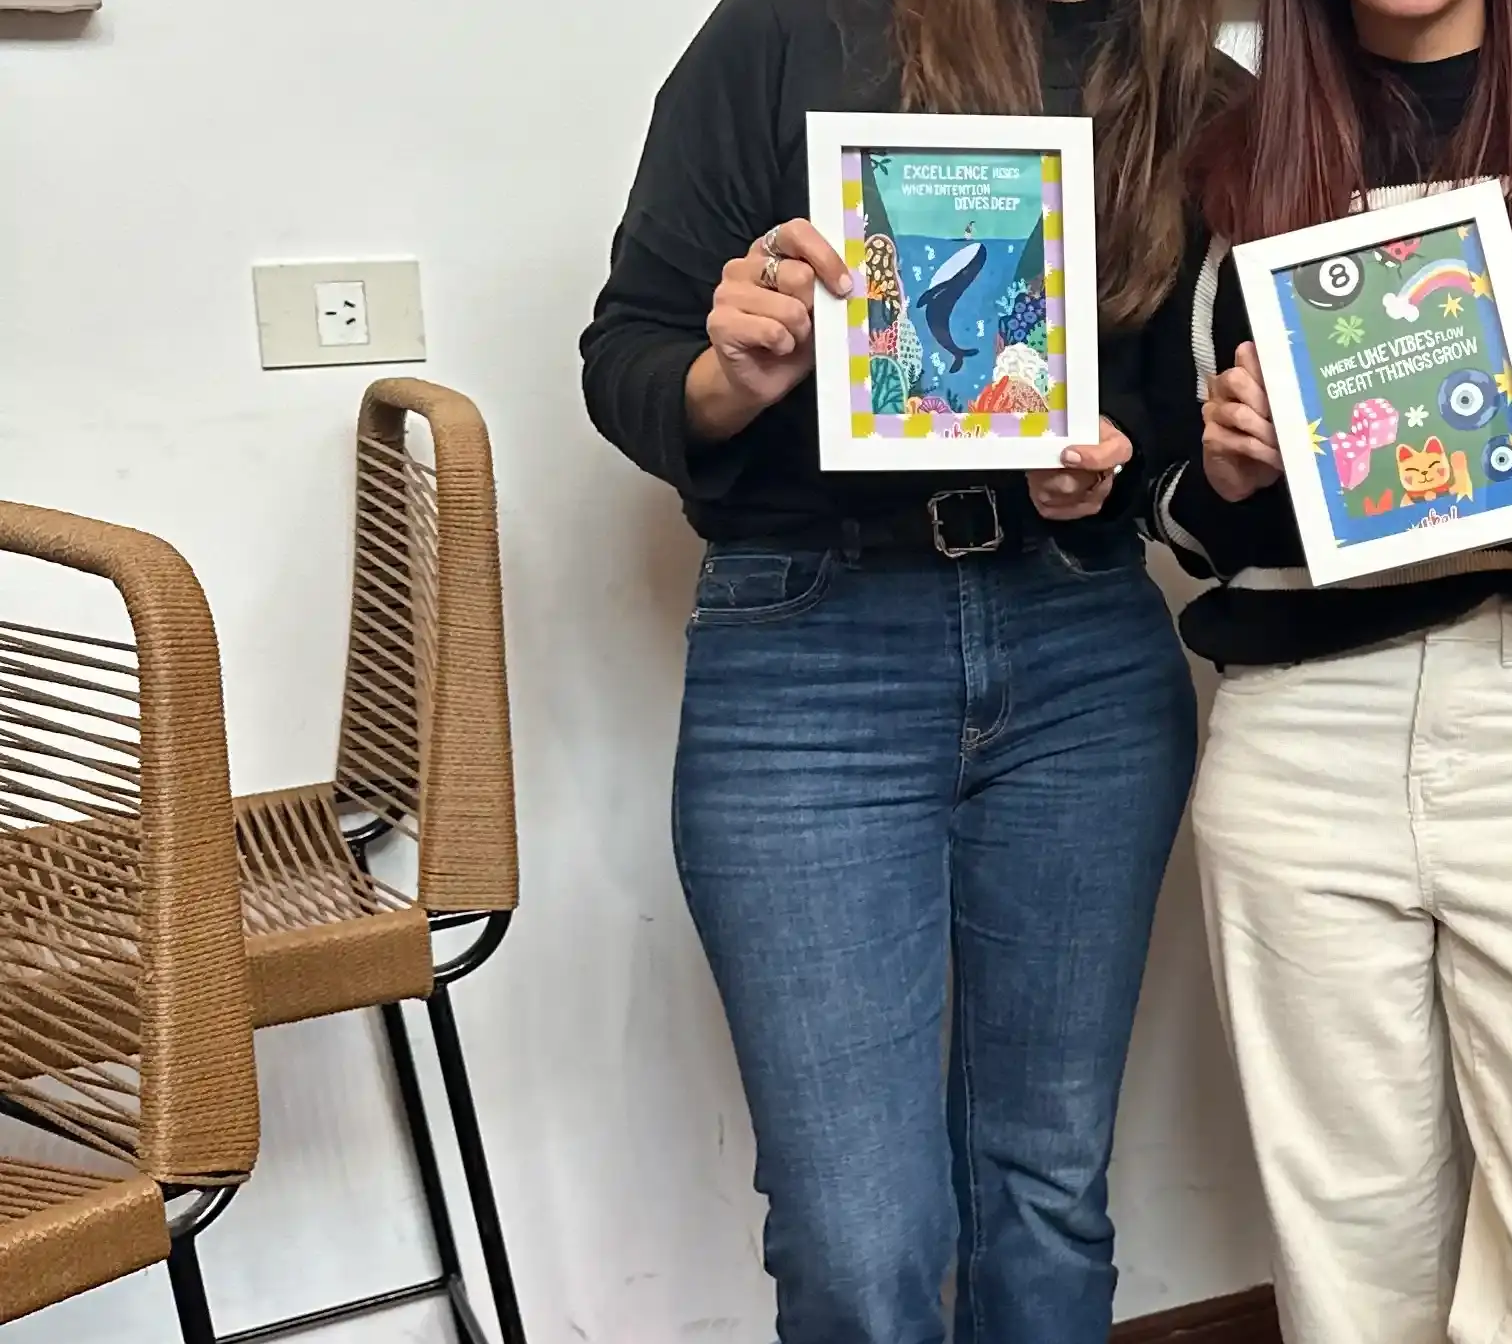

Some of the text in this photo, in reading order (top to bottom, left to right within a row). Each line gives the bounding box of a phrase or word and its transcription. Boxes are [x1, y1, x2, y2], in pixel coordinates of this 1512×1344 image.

[903, 164, 989, 180] EXCELLENCE
[901, 183, 991, 197] WHEN INTENTION
[954, 197, 1021, 211] DIVES DEEP
[1329, 263, 1350, 288] 8
[1319, 325, 1464, 378] WHERE UKE VIBES FLOW
[1326, 336, 1478, 400] GREAT THINGS GROW
